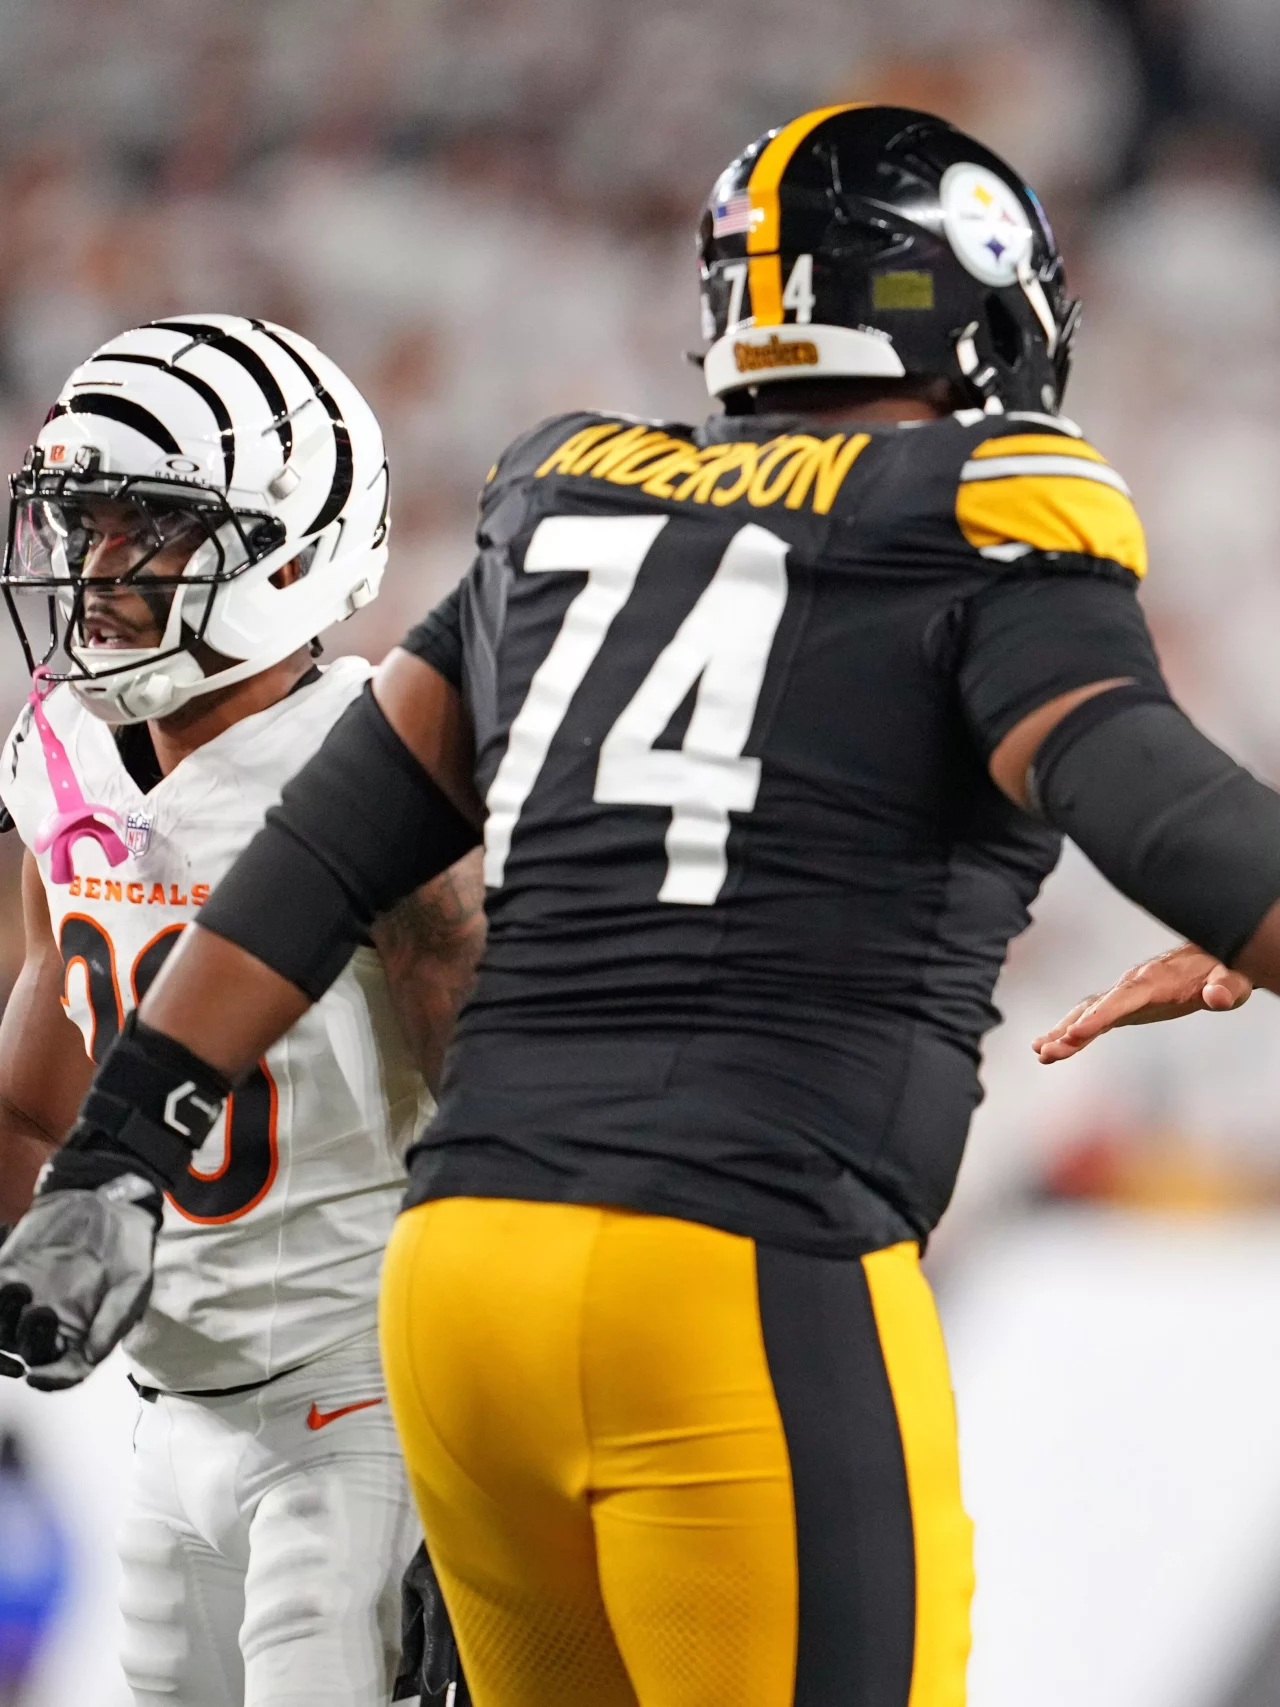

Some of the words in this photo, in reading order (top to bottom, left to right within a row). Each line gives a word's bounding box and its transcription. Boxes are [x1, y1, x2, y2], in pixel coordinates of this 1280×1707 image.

[534, 423, 871, 515] ANDERSON
[483, 515, 791, 905] 74
[127, 830, 145, 848] NFL
[69, 875, 210, 907] BENGALS
